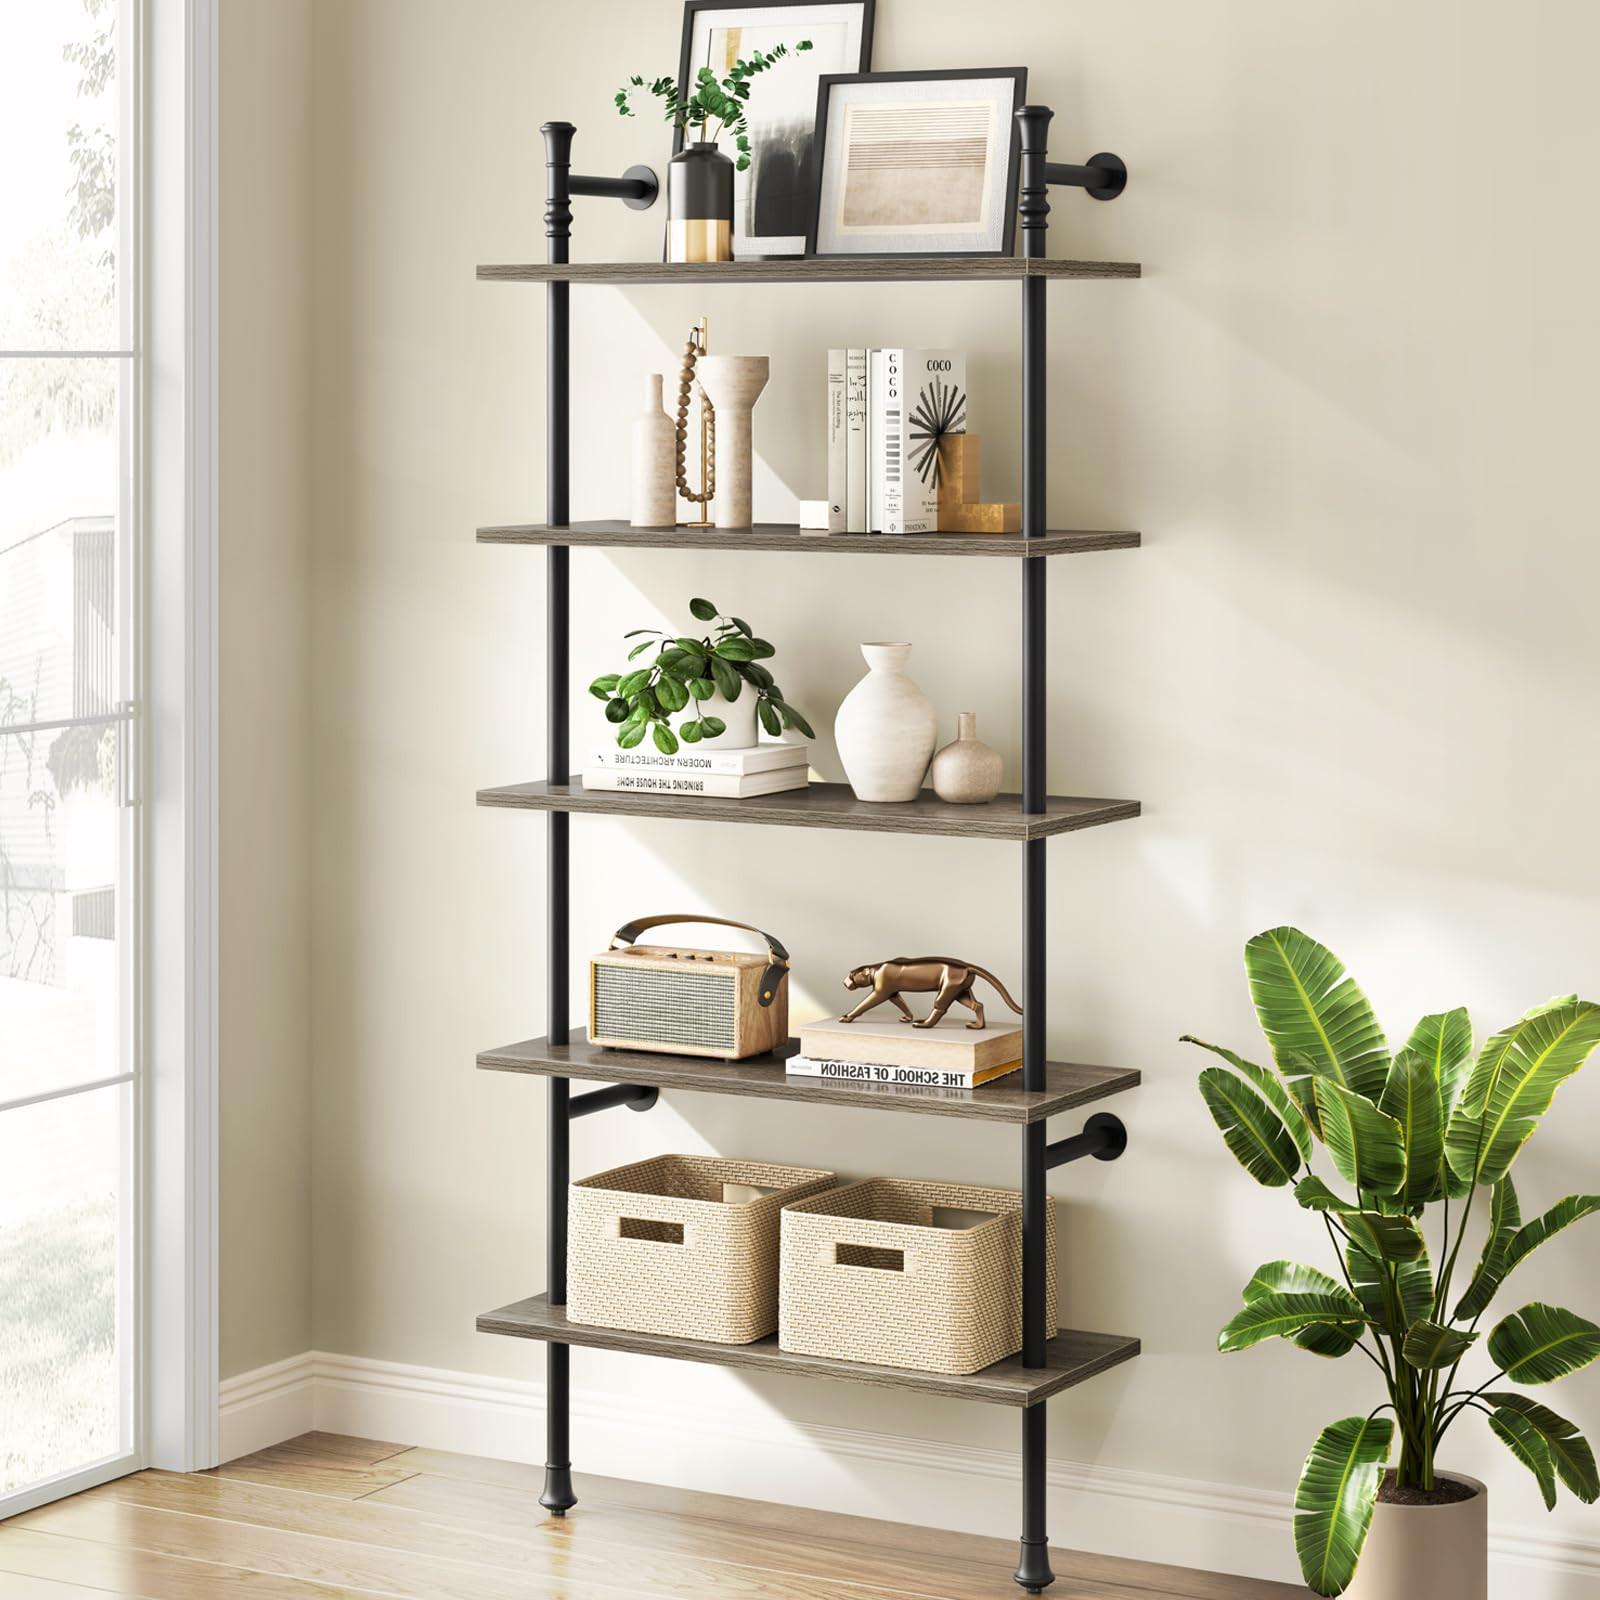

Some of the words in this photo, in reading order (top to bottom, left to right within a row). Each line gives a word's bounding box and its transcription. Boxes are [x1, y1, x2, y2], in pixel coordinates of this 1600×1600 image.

[927, 359, 951, 372] COCO
[889, 353, 897, 399] COCO
[615, 754, 675, 767] ARCHITECTURE
[677, 759, 712, 769] MODERN
[636, 777, 657, 788] HOUSE
[659, 778, 671, 789] THE
[673, 780, 704, 791] BRINGING
